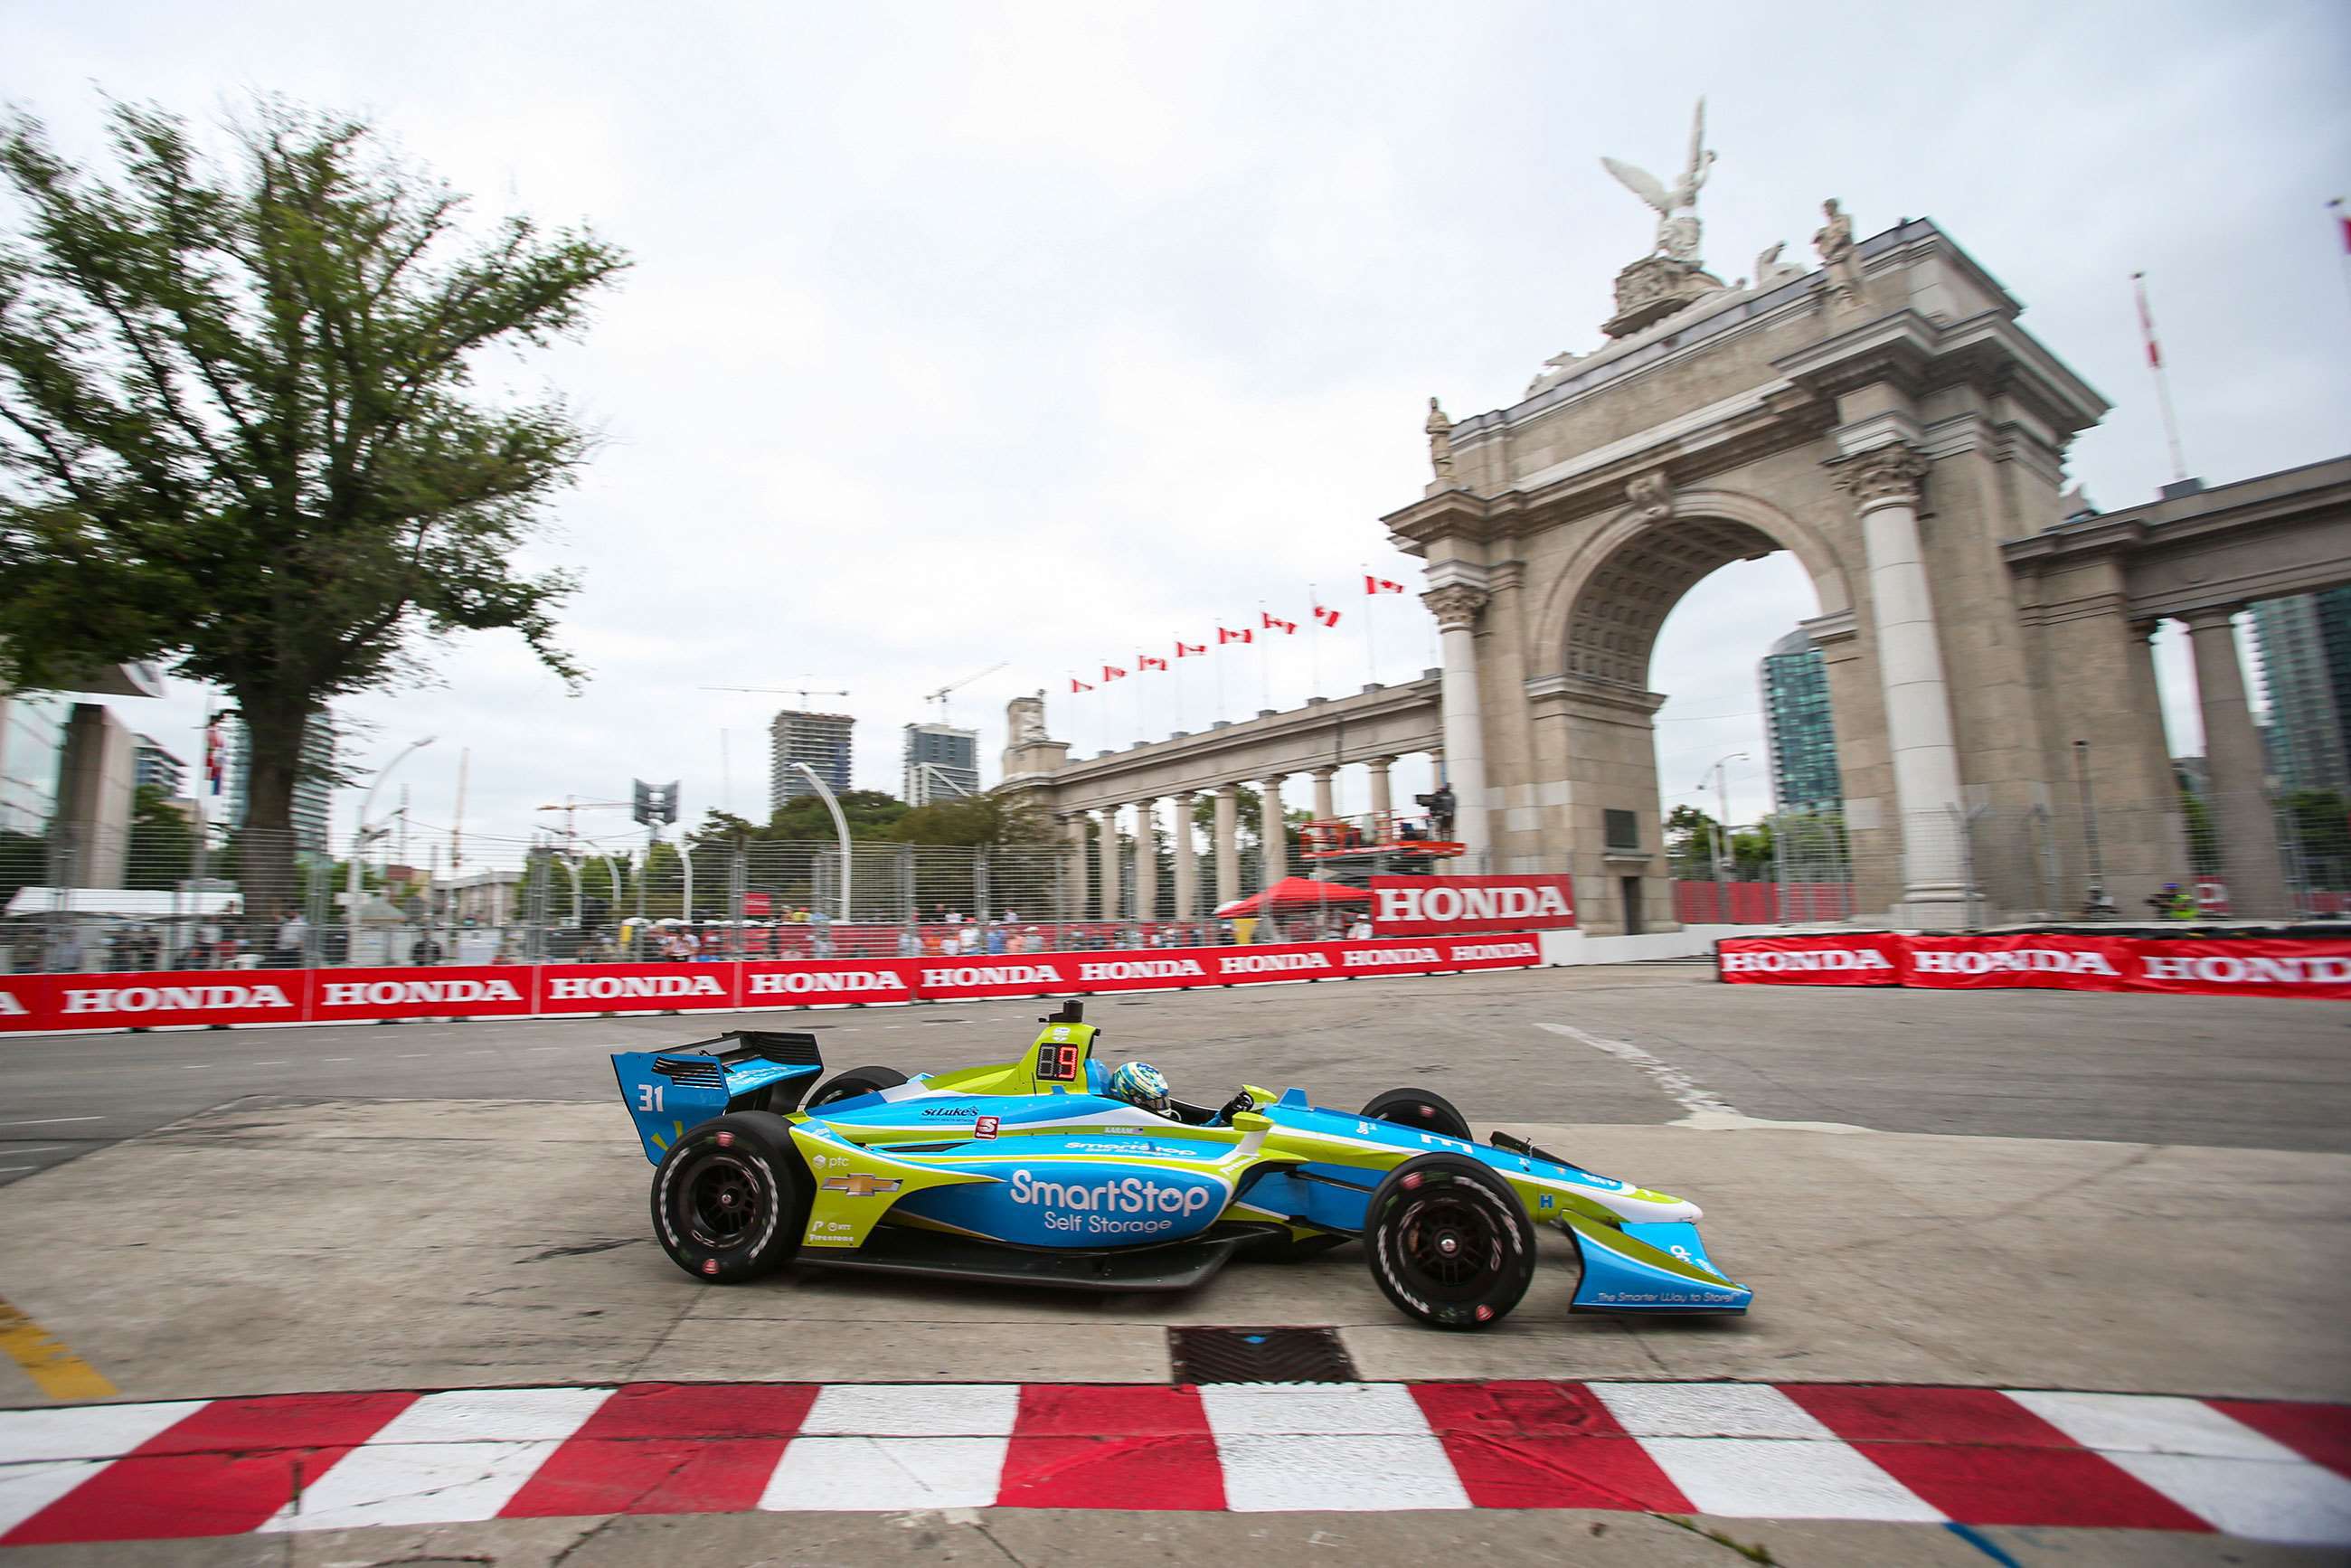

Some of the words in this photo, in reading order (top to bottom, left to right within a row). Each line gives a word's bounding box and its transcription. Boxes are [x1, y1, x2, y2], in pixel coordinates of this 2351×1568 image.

[1374, 886, 1572, 921] HONDA
[1219, 952, 1332, 974] HONDA
[1342, 948, 1441, 966] HONDA
[1450, 943, 1538, 960] HONDA
[1721, 949, 1894, 971] HONDA
[1912, 950, 2120, 976] HONDA
[921, 965, 1063, 987] HONDA
[1079, 959, 1206, 981] HONDA
[2142, 957, 2351, 983] HOND
[322, 980, 523, 1006] HONDA
[549, 976, 727, 999] HONDA
[750, 971, 907, 994] HONDA
[62, 986, 293, 1014] HONDA
[638, 1084, 665, 1112] 31
[1010, 1169, 1210, 1217] SmartStop
[1044, 1211, 1083, 1232] Self
[1088, 1214, 1173, 1233] Storage
[1597, 1292, 1615, 1302] The
[1617, 1291, 1657, 1302] Smarter
[1660, 1292, 1687, 1303] Way
[1689, 1292, 1701, 1301] to
